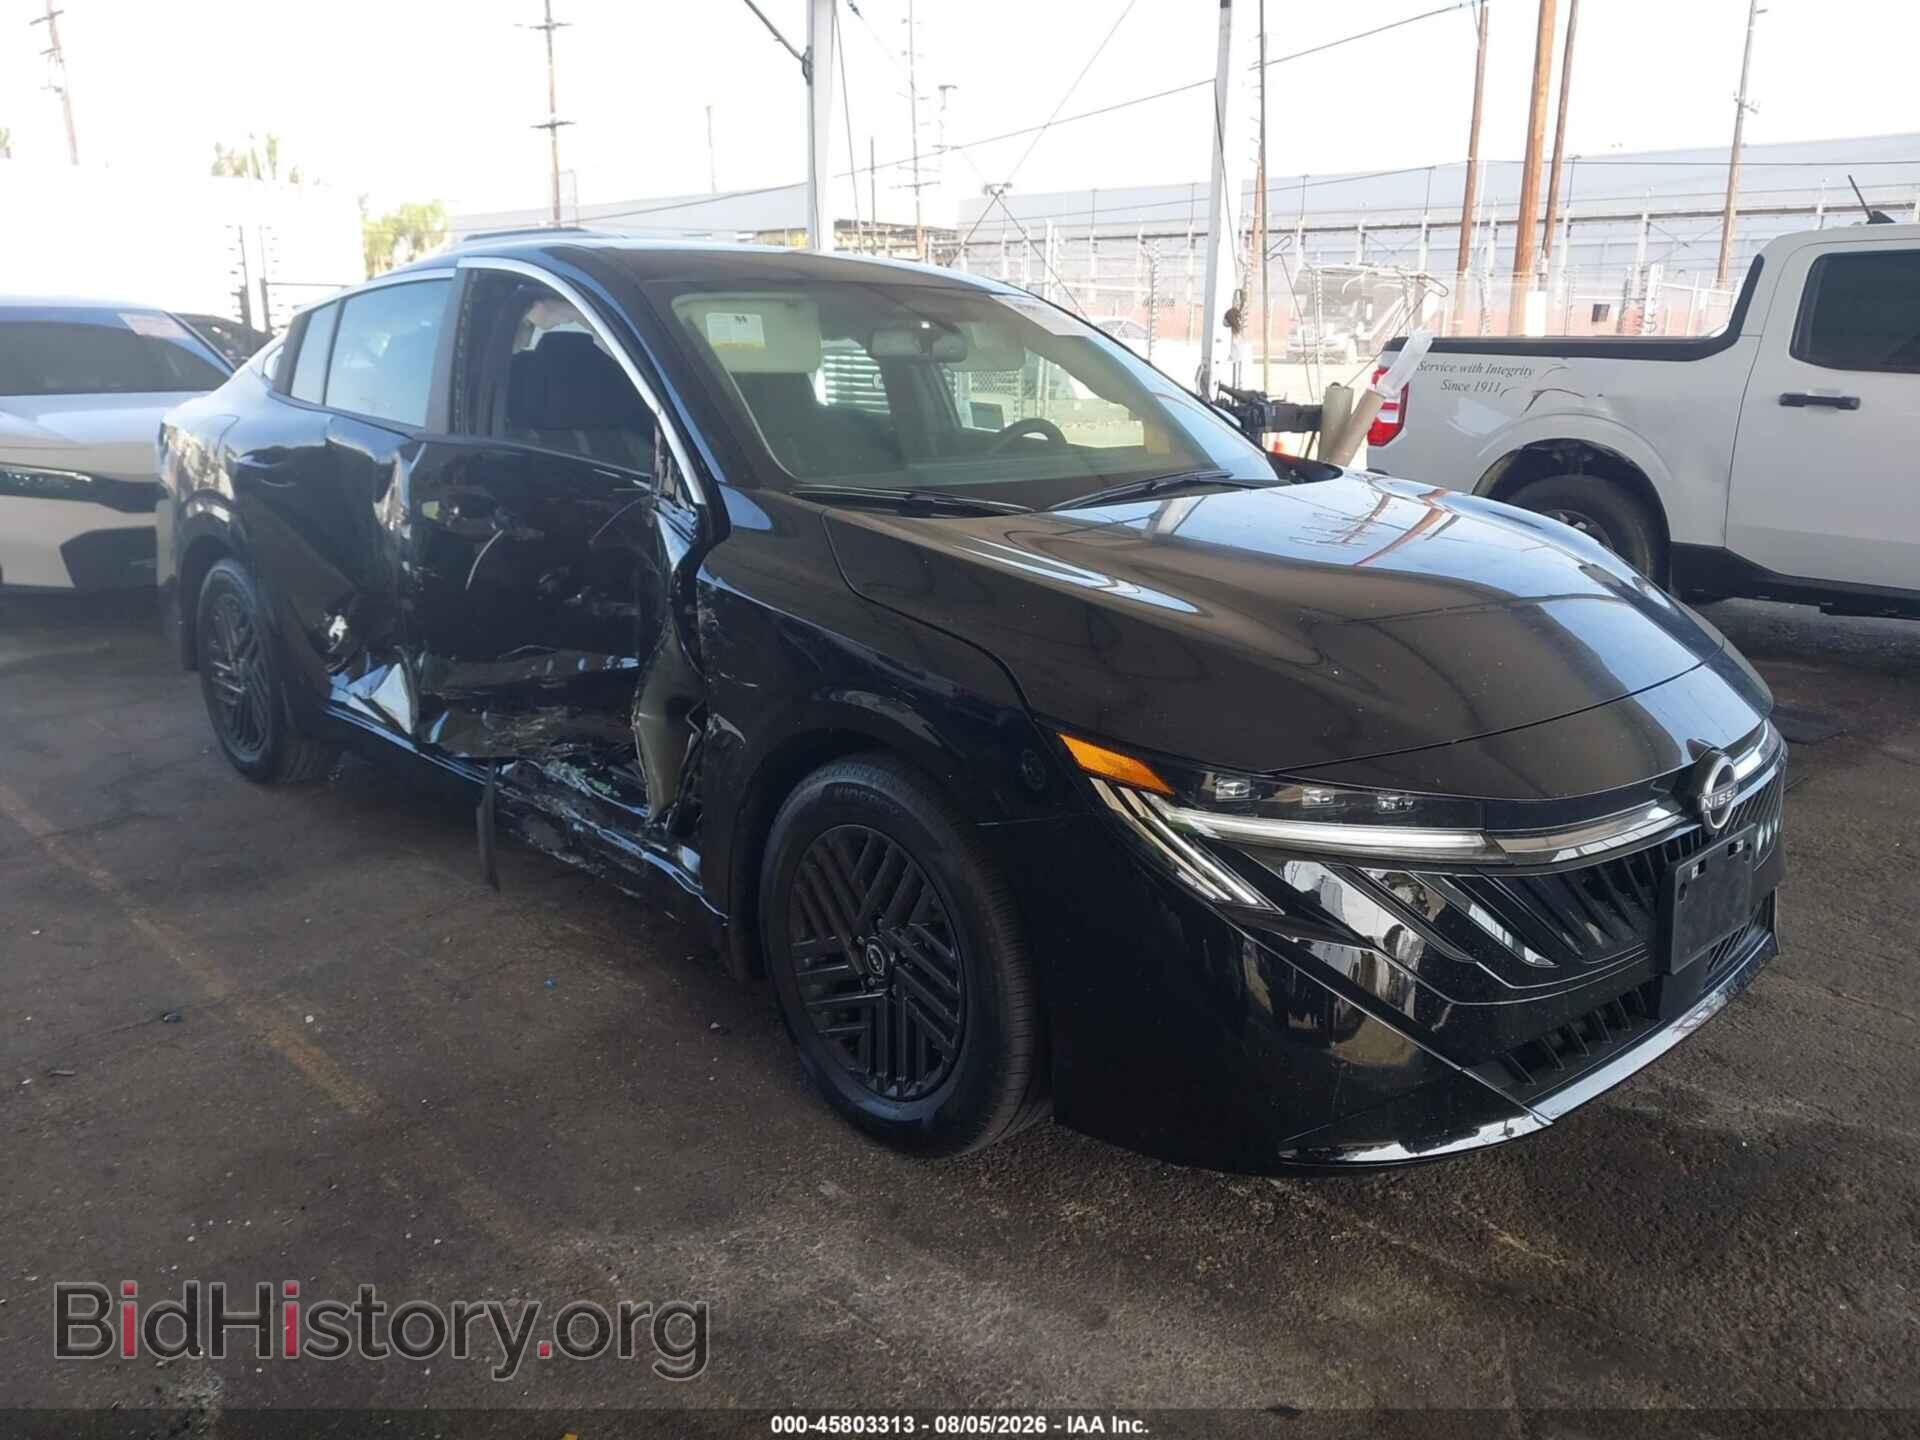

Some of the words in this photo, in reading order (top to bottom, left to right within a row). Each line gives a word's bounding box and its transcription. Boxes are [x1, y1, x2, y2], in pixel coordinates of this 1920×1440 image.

[1418, 361, 1457, 373] Service
[1460, 362, 1484, 374] with
[1486, 363, 1535, 378] Integrity
[1440, 380, 1471, 392] Since
[1474, 381, 1501, 393] 1911
[1702, 790, 1736, 809] NISS
